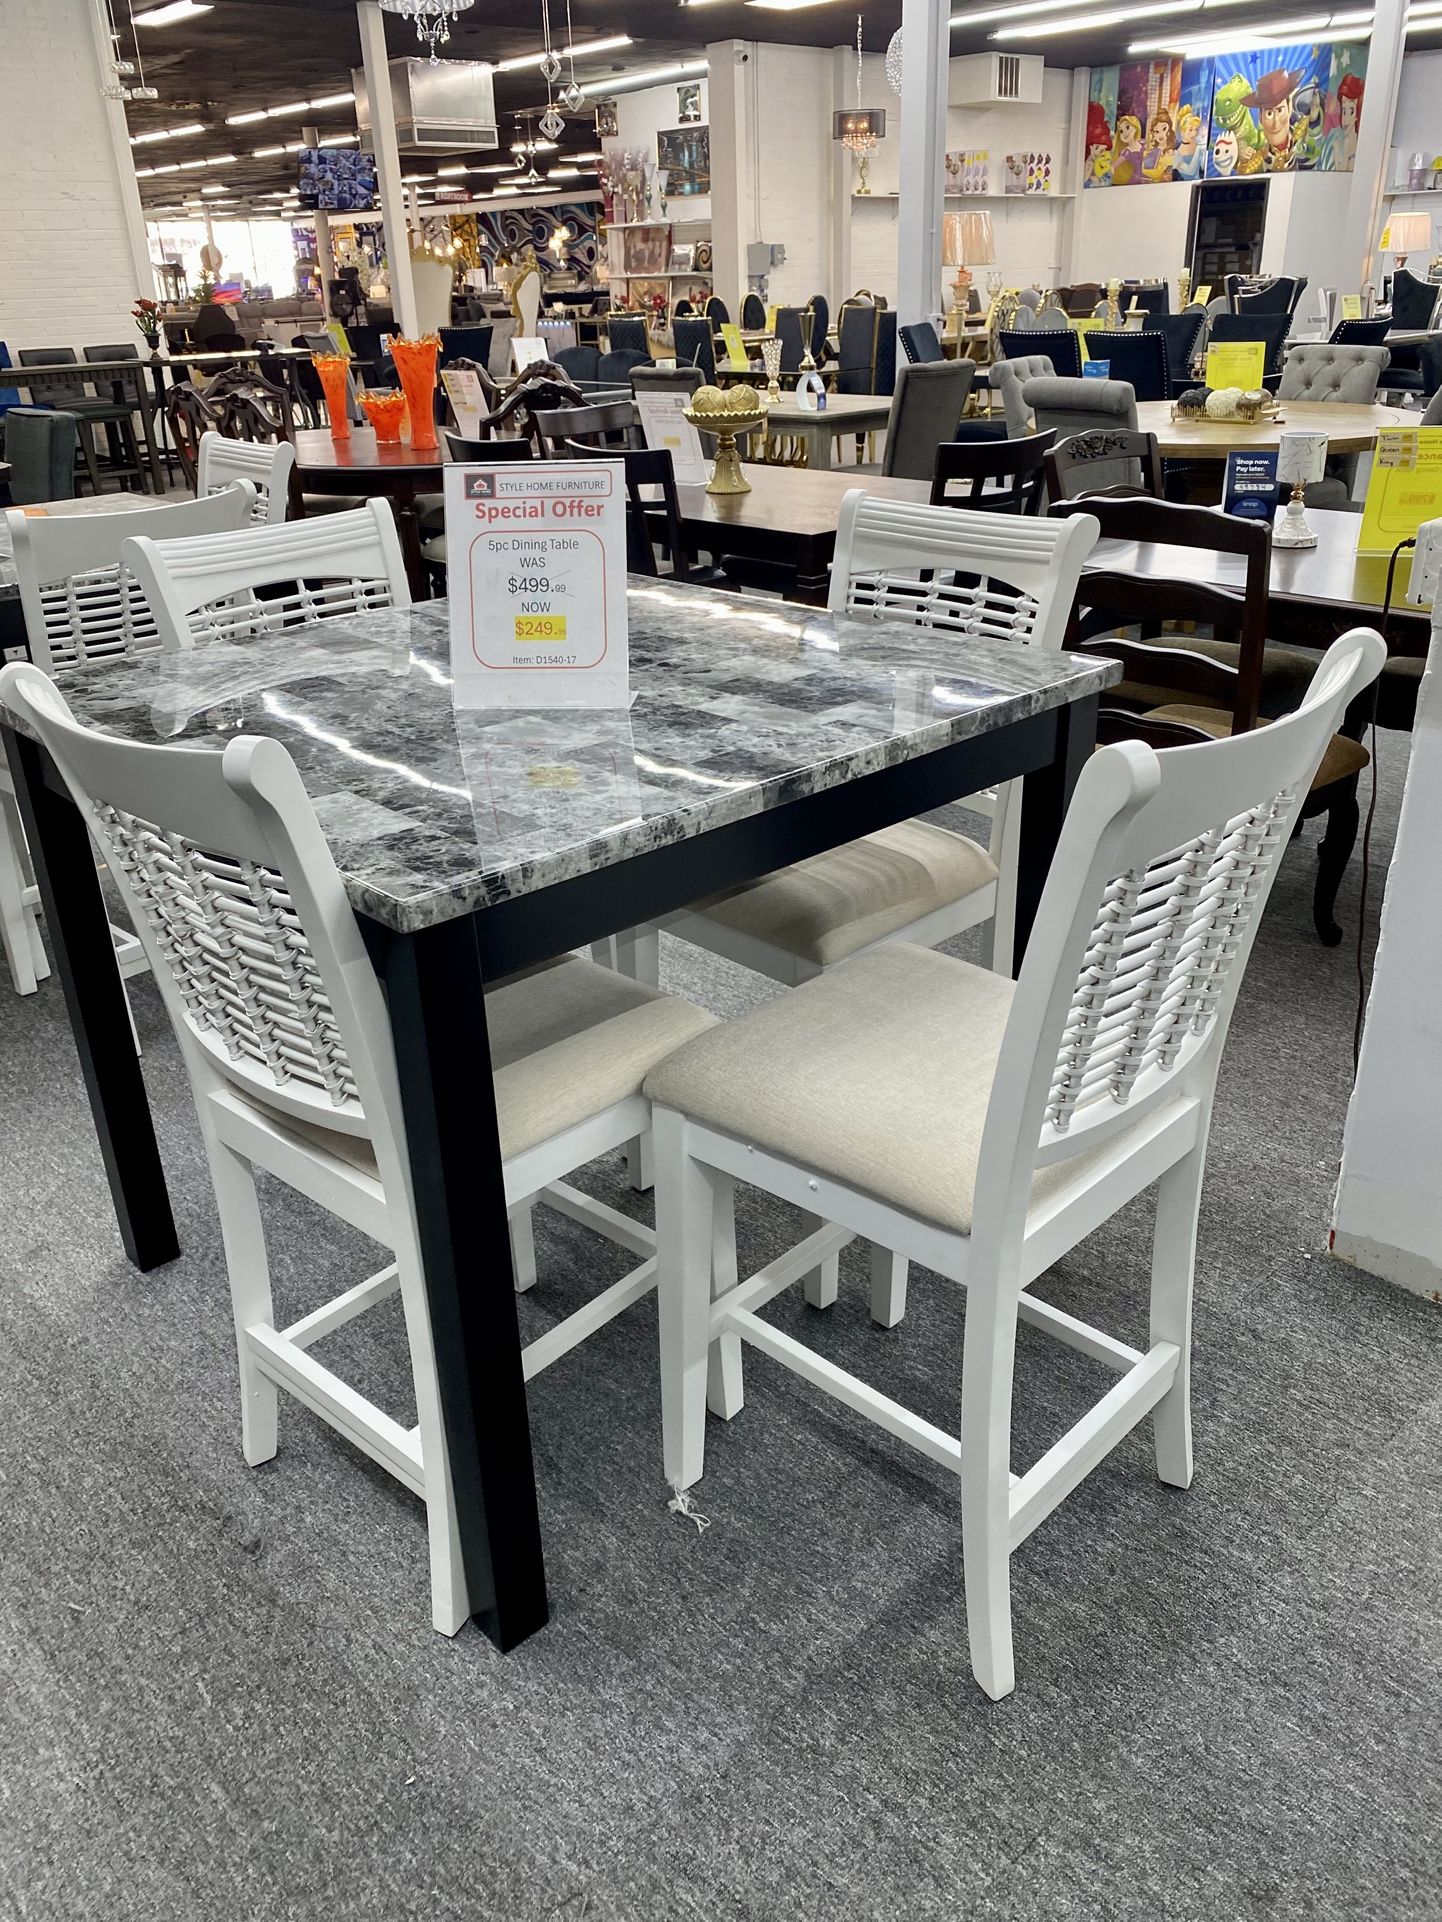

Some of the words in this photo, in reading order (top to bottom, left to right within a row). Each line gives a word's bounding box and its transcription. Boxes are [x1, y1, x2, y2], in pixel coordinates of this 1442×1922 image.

[500, 482, 524, 492] STYLE
[526, 481, 554, 491] HOME
[556, 480, 606, 490] FURNITURE
[475, 500, 545, 524] Special
[552, 500, 605, 518] Offer
[488, 540, 509, 553] 5pc
[512, 539, 548, 552] Dining
[549, 539, 580, 550] Table
[519, 557, 546, 568] WAS
[508, 576, 567, 595] $499.99
[521, 602, 551, 613] NOW
[512, 656, 534, 664] Item:
[536, 656, 577, 664] D1540-17
